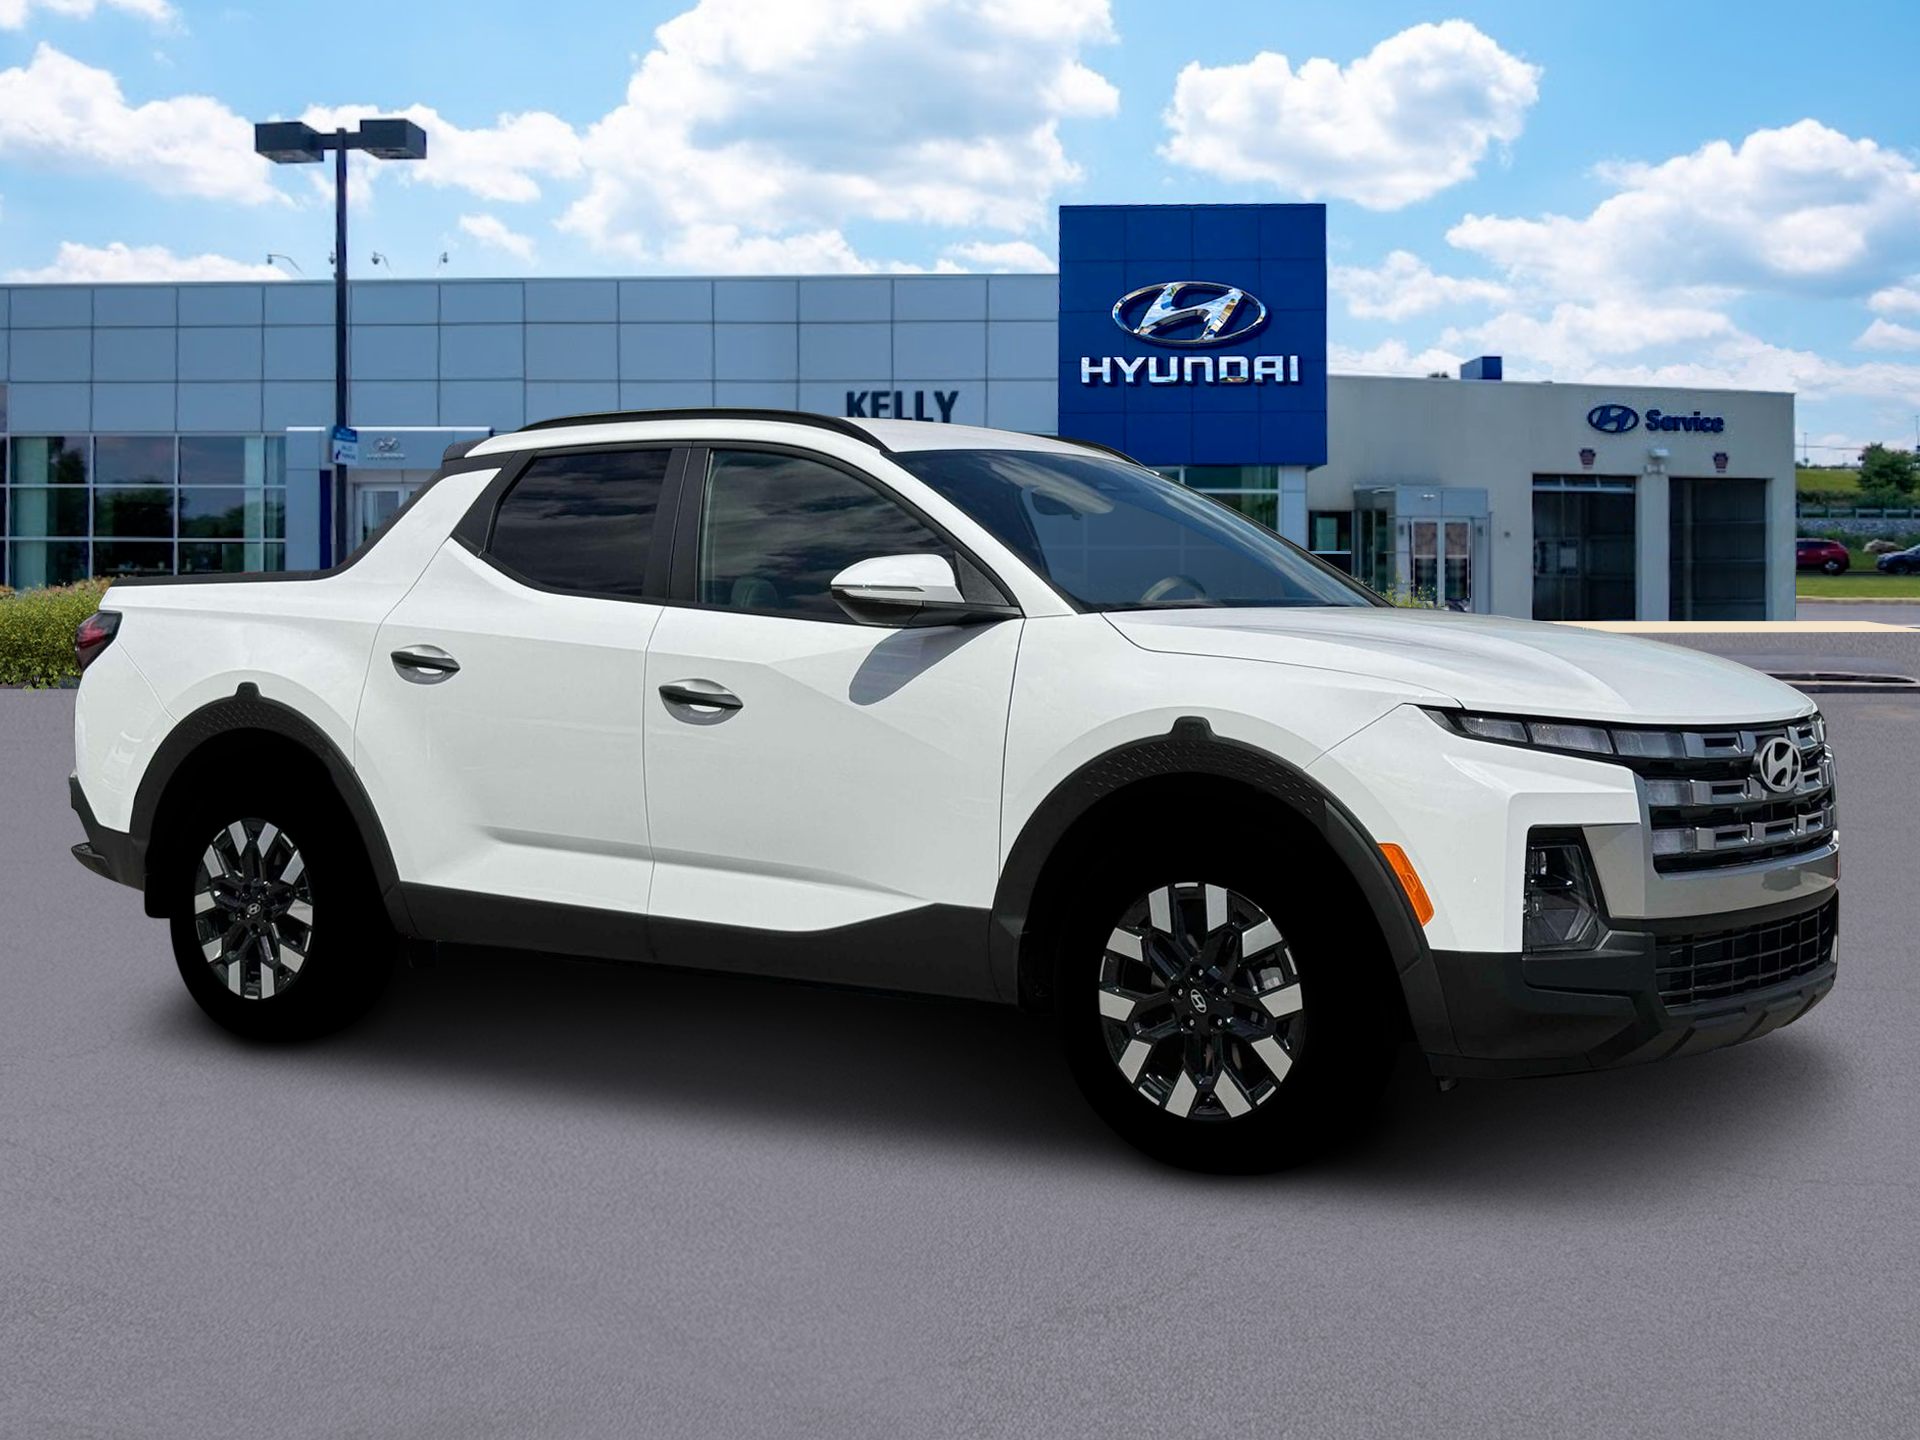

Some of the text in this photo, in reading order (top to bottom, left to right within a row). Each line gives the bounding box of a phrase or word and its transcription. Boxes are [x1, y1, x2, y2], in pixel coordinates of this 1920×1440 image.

[1081, 355, 1299, 384] HYUNDAI
[846, 390, 959, 423] KELLY
[1645, 409, 1725, 433] Service
